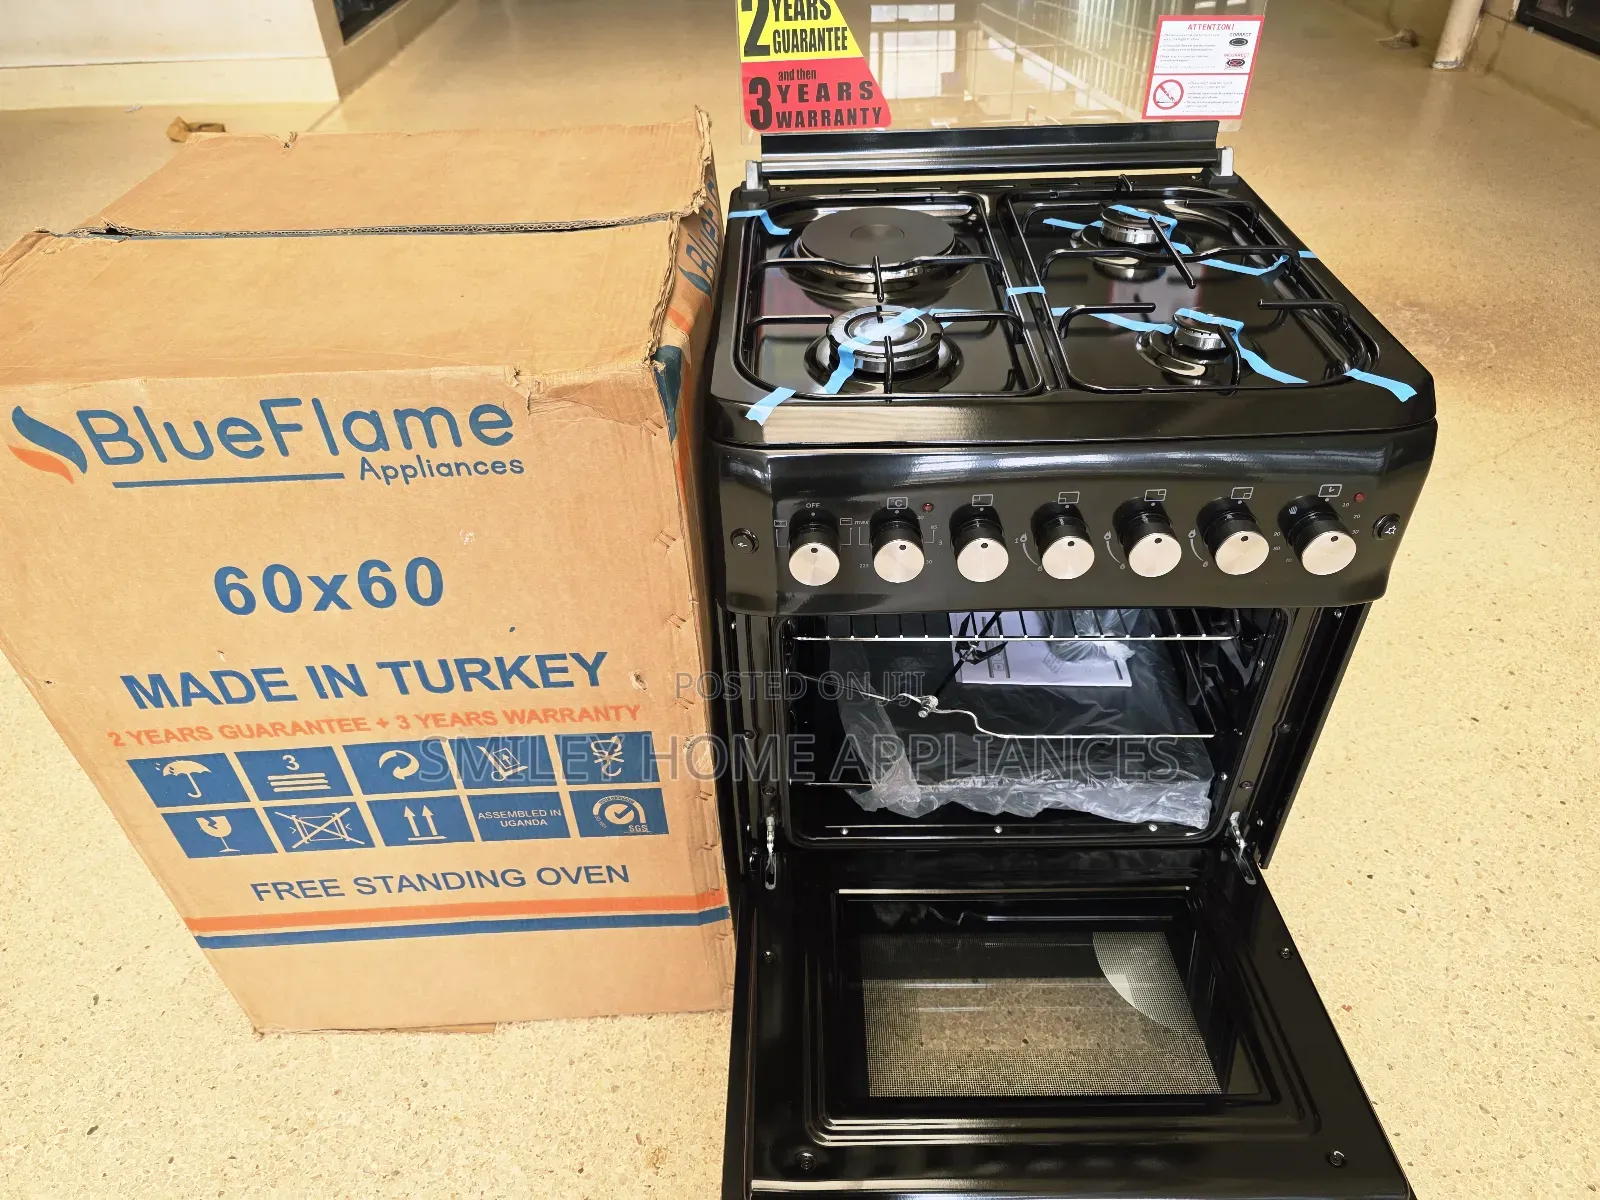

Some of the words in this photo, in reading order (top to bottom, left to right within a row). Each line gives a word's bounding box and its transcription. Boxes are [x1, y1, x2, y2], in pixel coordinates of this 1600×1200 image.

[772, 0, 832, 22] YEARS
[741, 0, 771, 57] 2
[1187, 23, 1235, 31] ATTENTION!
[772, 27, 848, 54] GUARANTEE
[778, 70, 795, 81] and
[797, 68, 817, 81] then
[749, 77, 773, 130] 3
[777, 80, 874, 104] YEARS
[776, 107, 882, 129] WARRANTY
[76, 397, 514, 467] BlueFlame
[359, 454, 525, 486] Appliances
[213, 556, 444, 616] 60x60
[119, 666, 297, 710] MADE
[306, 663, 369, 699] IN
[376, 651, 608, 696] TURKEY
[106, 732, 127, 748] 2
[125, 725, 213, 747] YEARS
[217, 717, 371, 740] GUARANTEE
[376, 717, 390, 730] +
[398, 713, 411, 730] 3
[412, 710, 498, 729] YEARS
[500, 705, 641, 725] WARRANTY
[284, 754, 300, 771] 3
[478, 809, 547, 820] ASSEMBLED
[549, 809, 562, 817] IN
[500, 819, 548, 828] UGANDA
[628, 824, 648, 832] SGS
[249, 877, 346, 902] FREE
[357, 869, 527, 896] STANDING
[535, 864, 631, 886] OVEN
